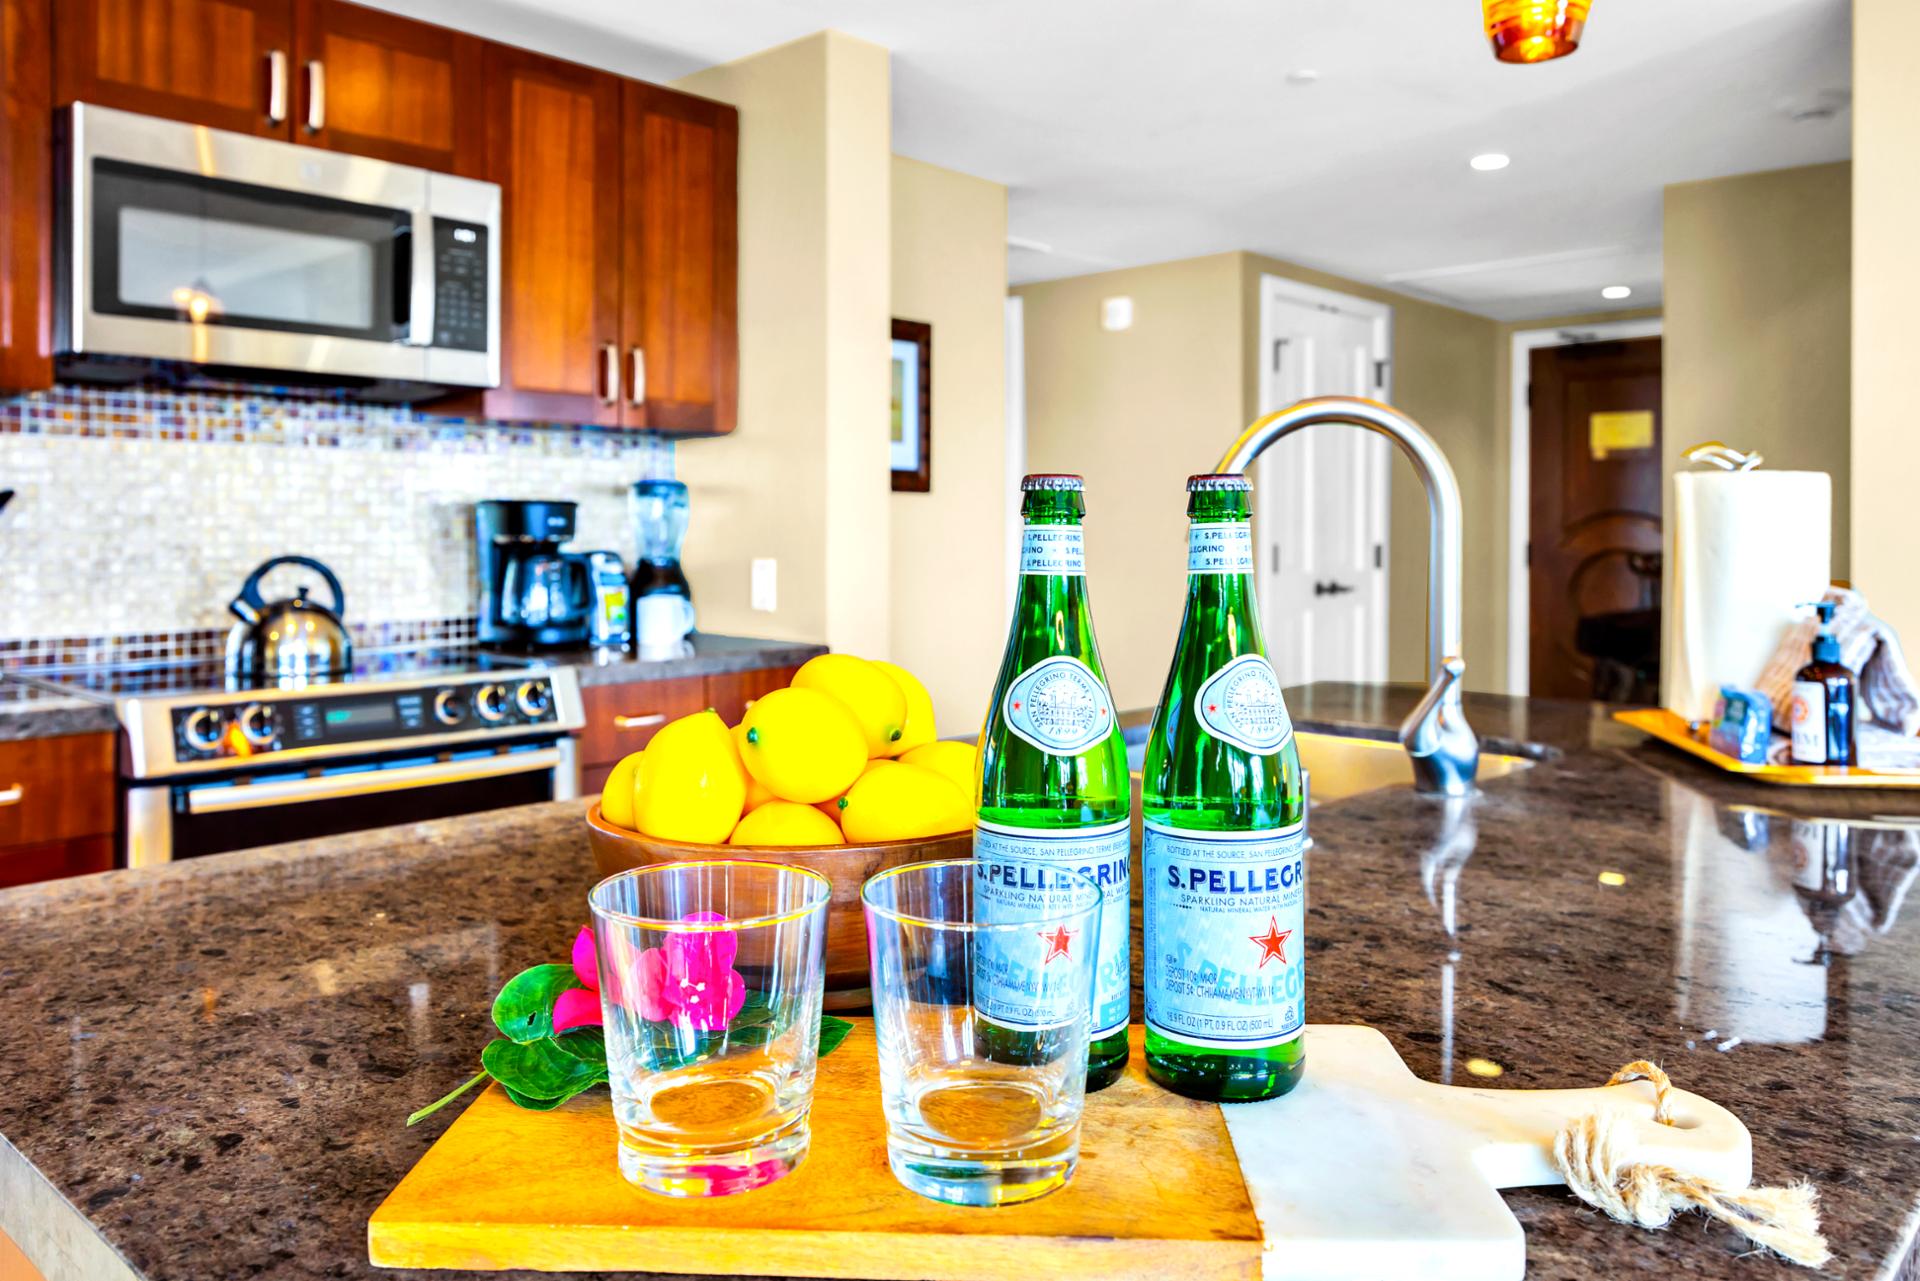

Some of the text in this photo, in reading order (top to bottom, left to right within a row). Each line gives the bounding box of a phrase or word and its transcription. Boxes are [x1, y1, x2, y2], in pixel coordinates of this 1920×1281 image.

[1029, 671, 1067, 708] PELLEGRINO
[1040, 848, 1056, 857] SAN
[1193, 849, 1201, 857] AT
[1202, 849, 1216, 858] THE
[983, 884, 1026, 903] SPARKLING
[1028, 892, 1073, 904] NAURAL
[1180, 893, 1237, 907] SPARKLING
[1239, 895, 1281, 907] NATURAL
[1178, 1013, 1186, 1025] FL
[1186, 1015, 1196, 1027] OZ
[1215, 1019, 1226, 1031] 0.9
[1227, 1020, 1236, 1031] FL
